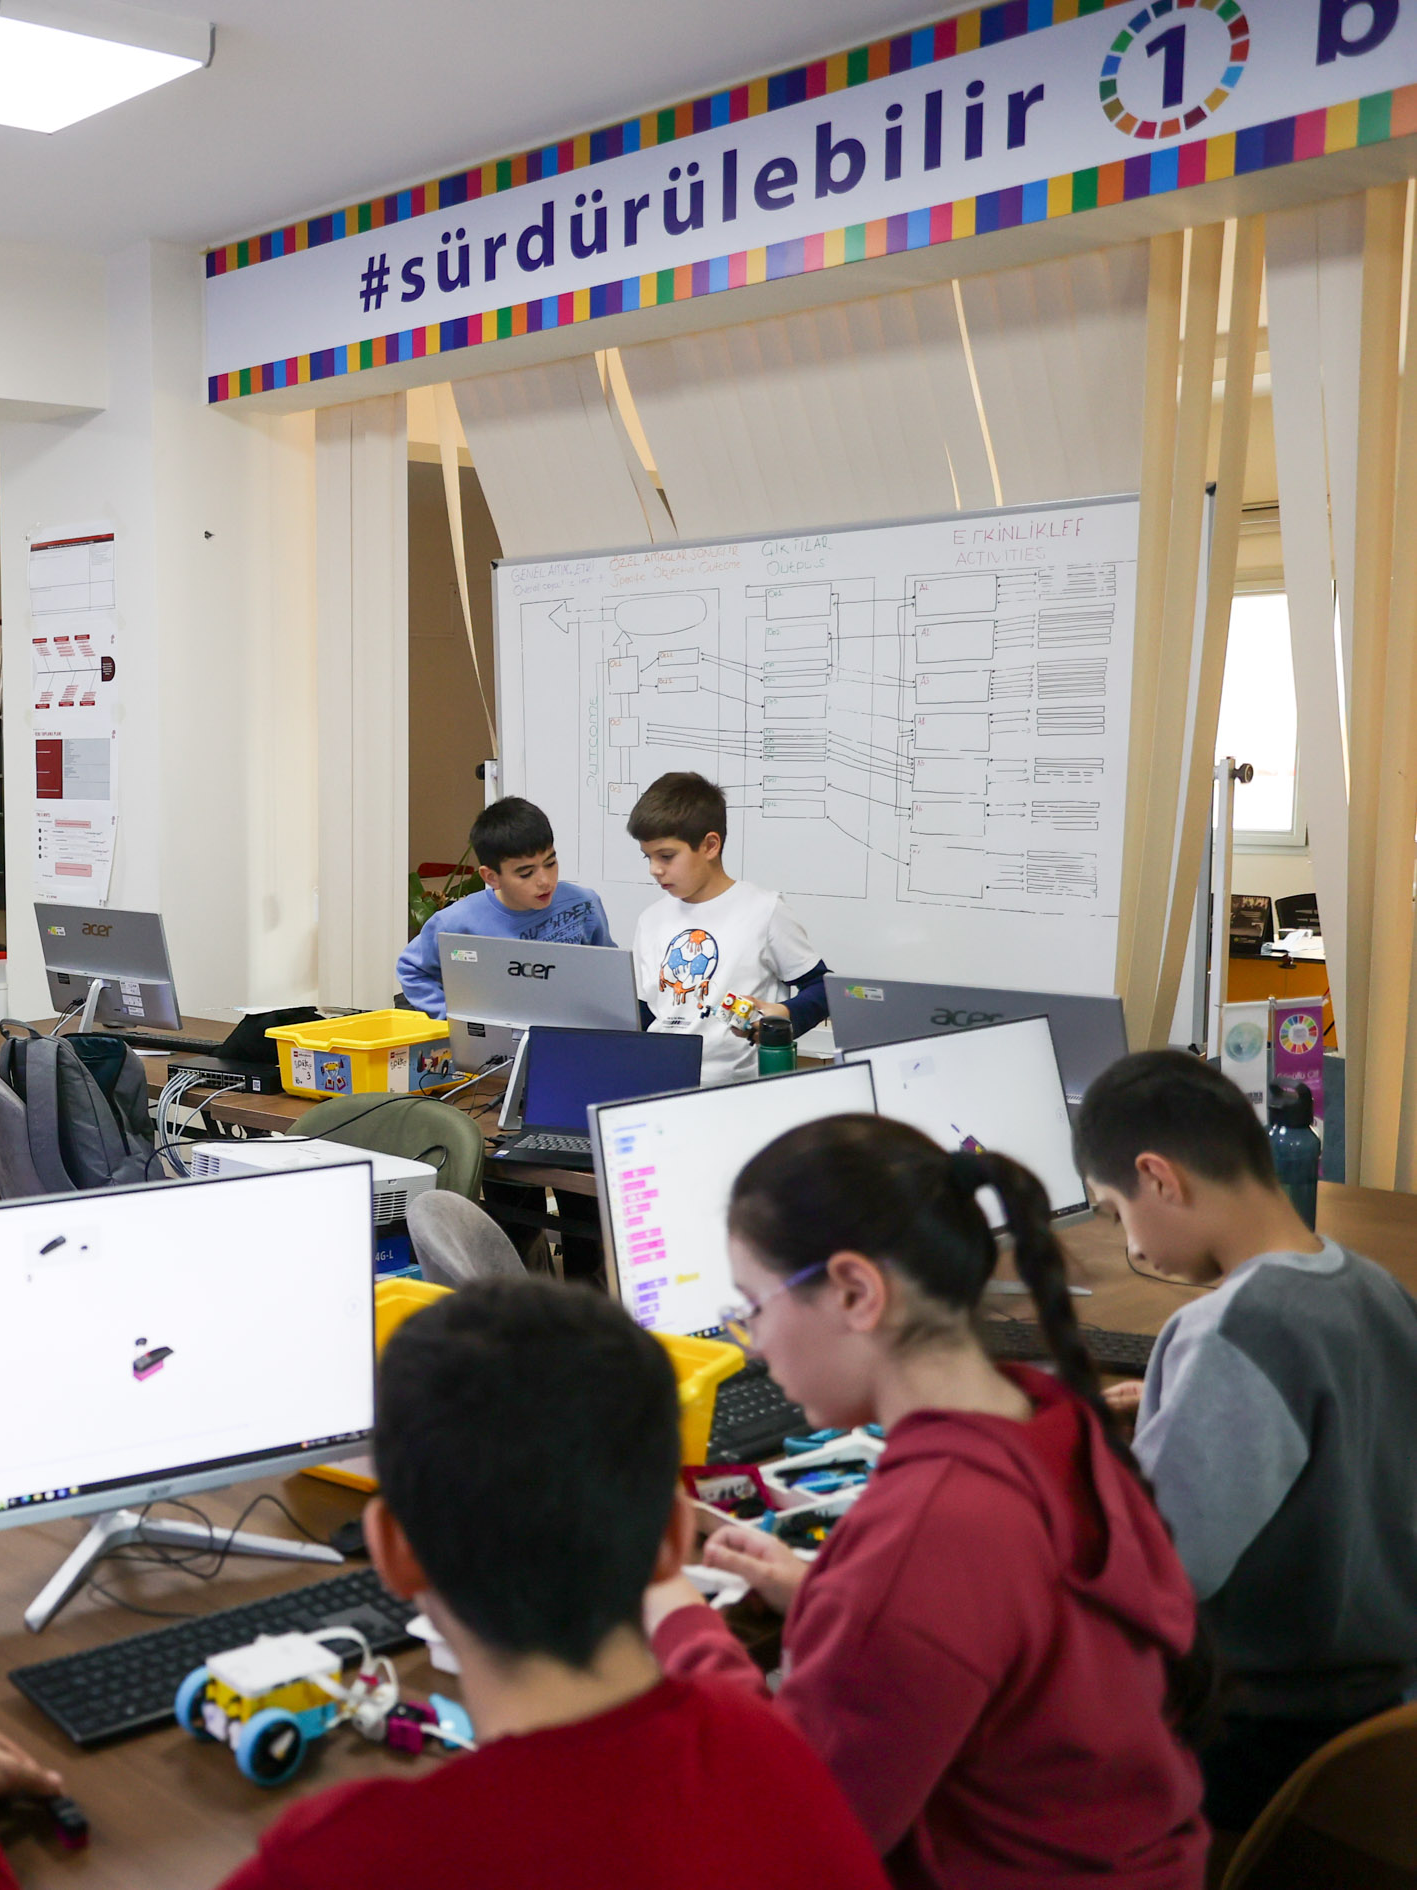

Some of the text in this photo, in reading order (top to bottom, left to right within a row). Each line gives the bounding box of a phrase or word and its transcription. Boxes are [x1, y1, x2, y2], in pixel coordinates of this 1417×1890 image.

[360, 0, 1400, 312] #sürdürülebilir 1 b
[82, 922, 113, 937] acer
[507, 960, 556, 980] acer
